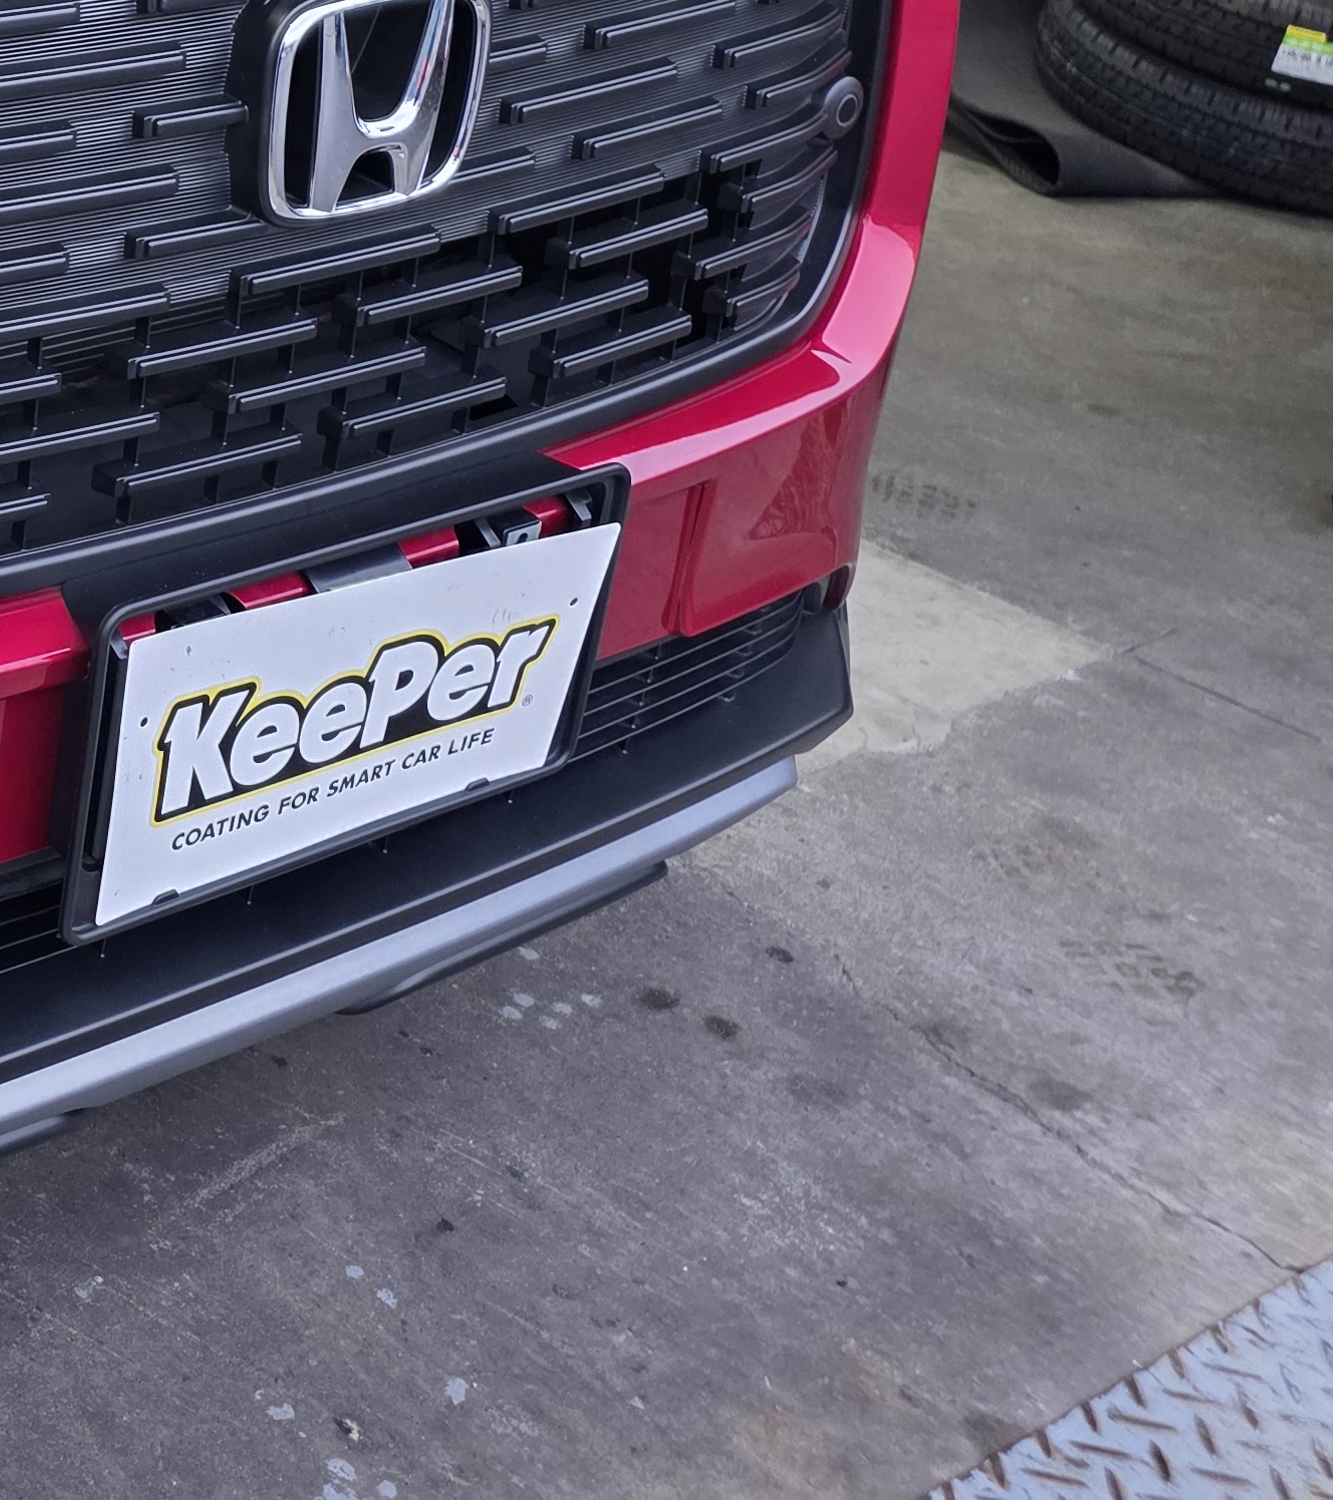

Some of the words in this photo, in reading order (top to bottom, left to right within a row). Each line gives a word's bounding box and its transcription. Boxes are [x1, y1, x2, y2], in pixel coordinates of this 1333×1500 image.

[154, 618, 556, 822] KeePer
[171, 804, 270, 851] COATING
[277, 787, 321, 815] FOR
[326, 760, 395, 797] SMART
[401, 744, 439, 770] CAR
[447, 727, 496, 755] LIFE
